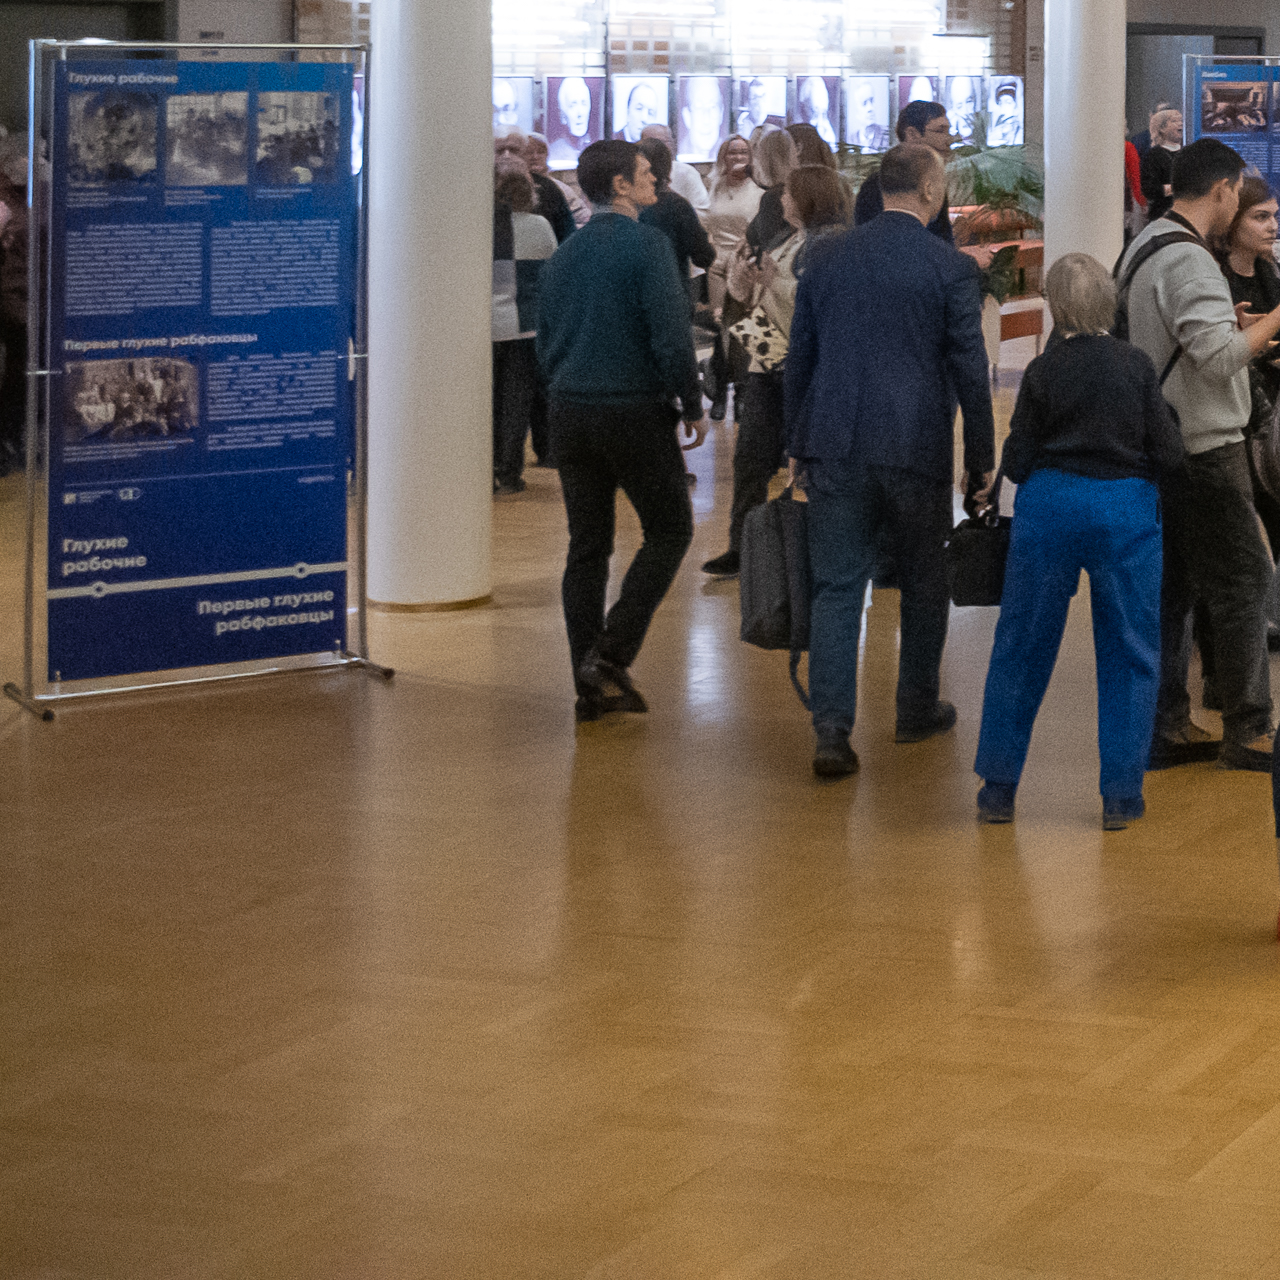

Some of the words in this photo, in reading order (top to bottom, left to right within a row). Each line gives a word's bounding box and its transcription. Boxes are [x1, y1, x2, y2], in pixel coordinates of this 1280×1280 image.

[69, 72, 116, 85] Глухие
[118, 72, 179, 85] рабочие
[64, 339, 119, 352] Первые
[122, 336, 168, 350] глухие
[170, 333, 258, 349] рабфаковцы
[63, 537, 129, 555] Глухие
[63, 556, 148, 577] рабочие
[197, 597, 271, 615] Первые
[274, 590, 335, 608] глухие
[216, 610, 335, 636] рабфаковцы
